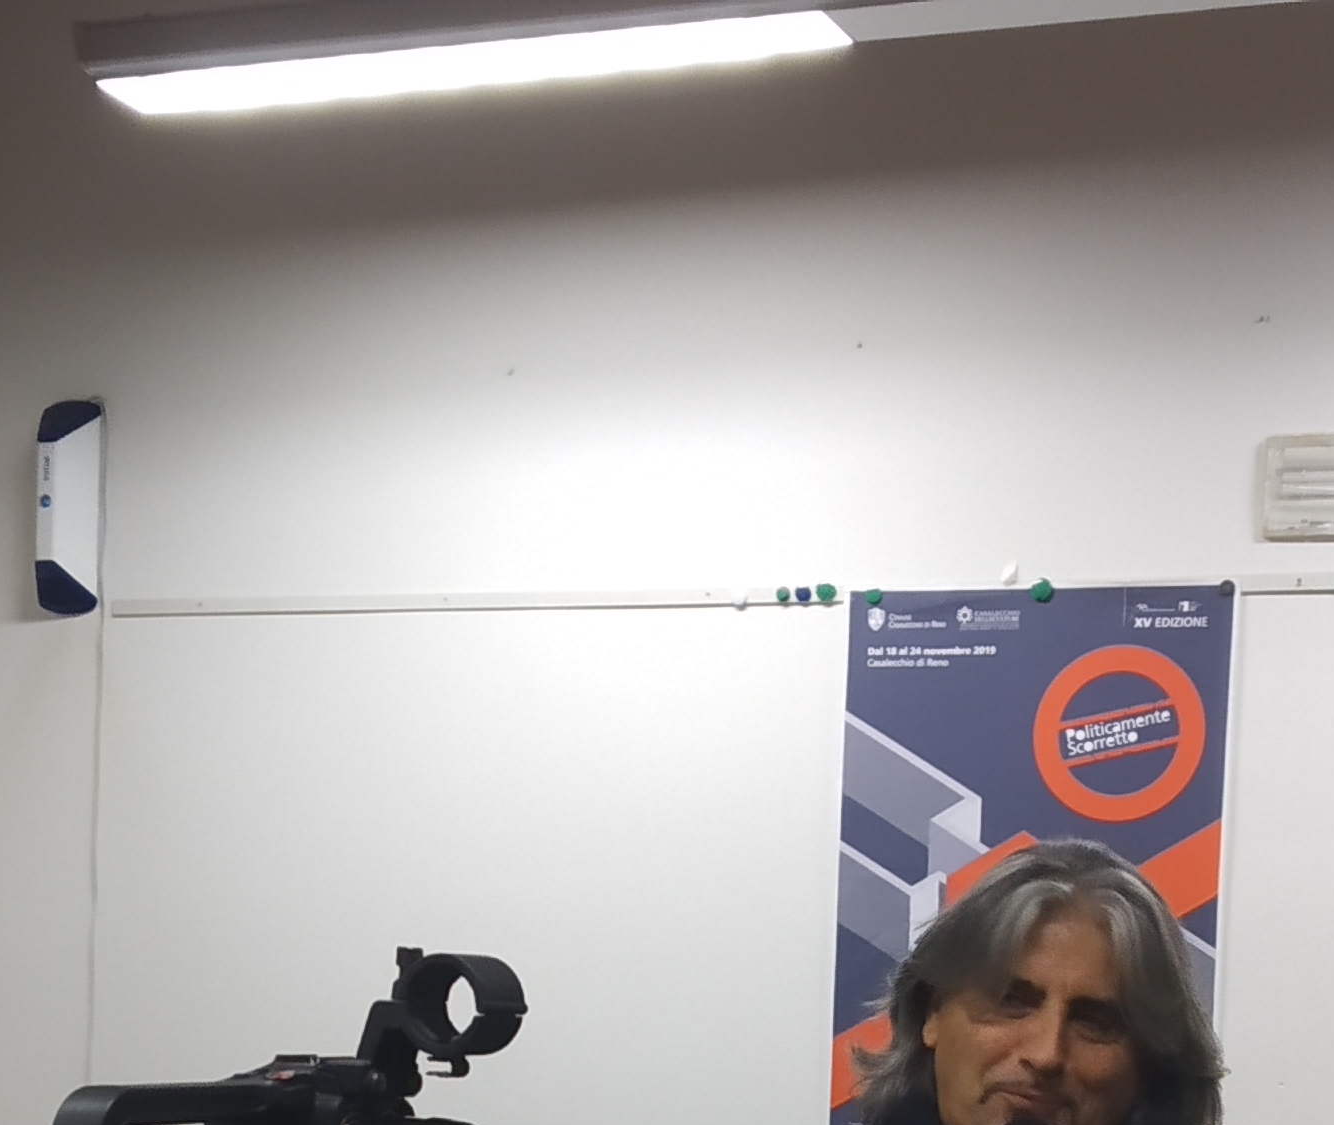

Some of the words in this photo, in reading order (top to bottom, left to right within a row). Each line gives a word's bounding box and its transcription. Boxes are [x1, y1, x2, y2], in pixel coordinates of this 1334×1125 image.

[1133, 617, 1152, 628] XV
[1154, 616, 1209, 628] EDIZIONE
[867, 646, 884, 655] Dal
[886, 646, 897, 655] 18
[898, 646, 908, 655] al
[909, 646, 922, 655] 24
[923, 645, 972, 655] novembre
[973, 645, 997, 655] 2019
[867, 658, 915, 667] Casalecchio
[916, 658, 924, 667] di
[927, 658, 950, 667] Reno
[1065, 710, 1171, 741] Politicamente
[1067, 731, 1139, 756] Scorretto
